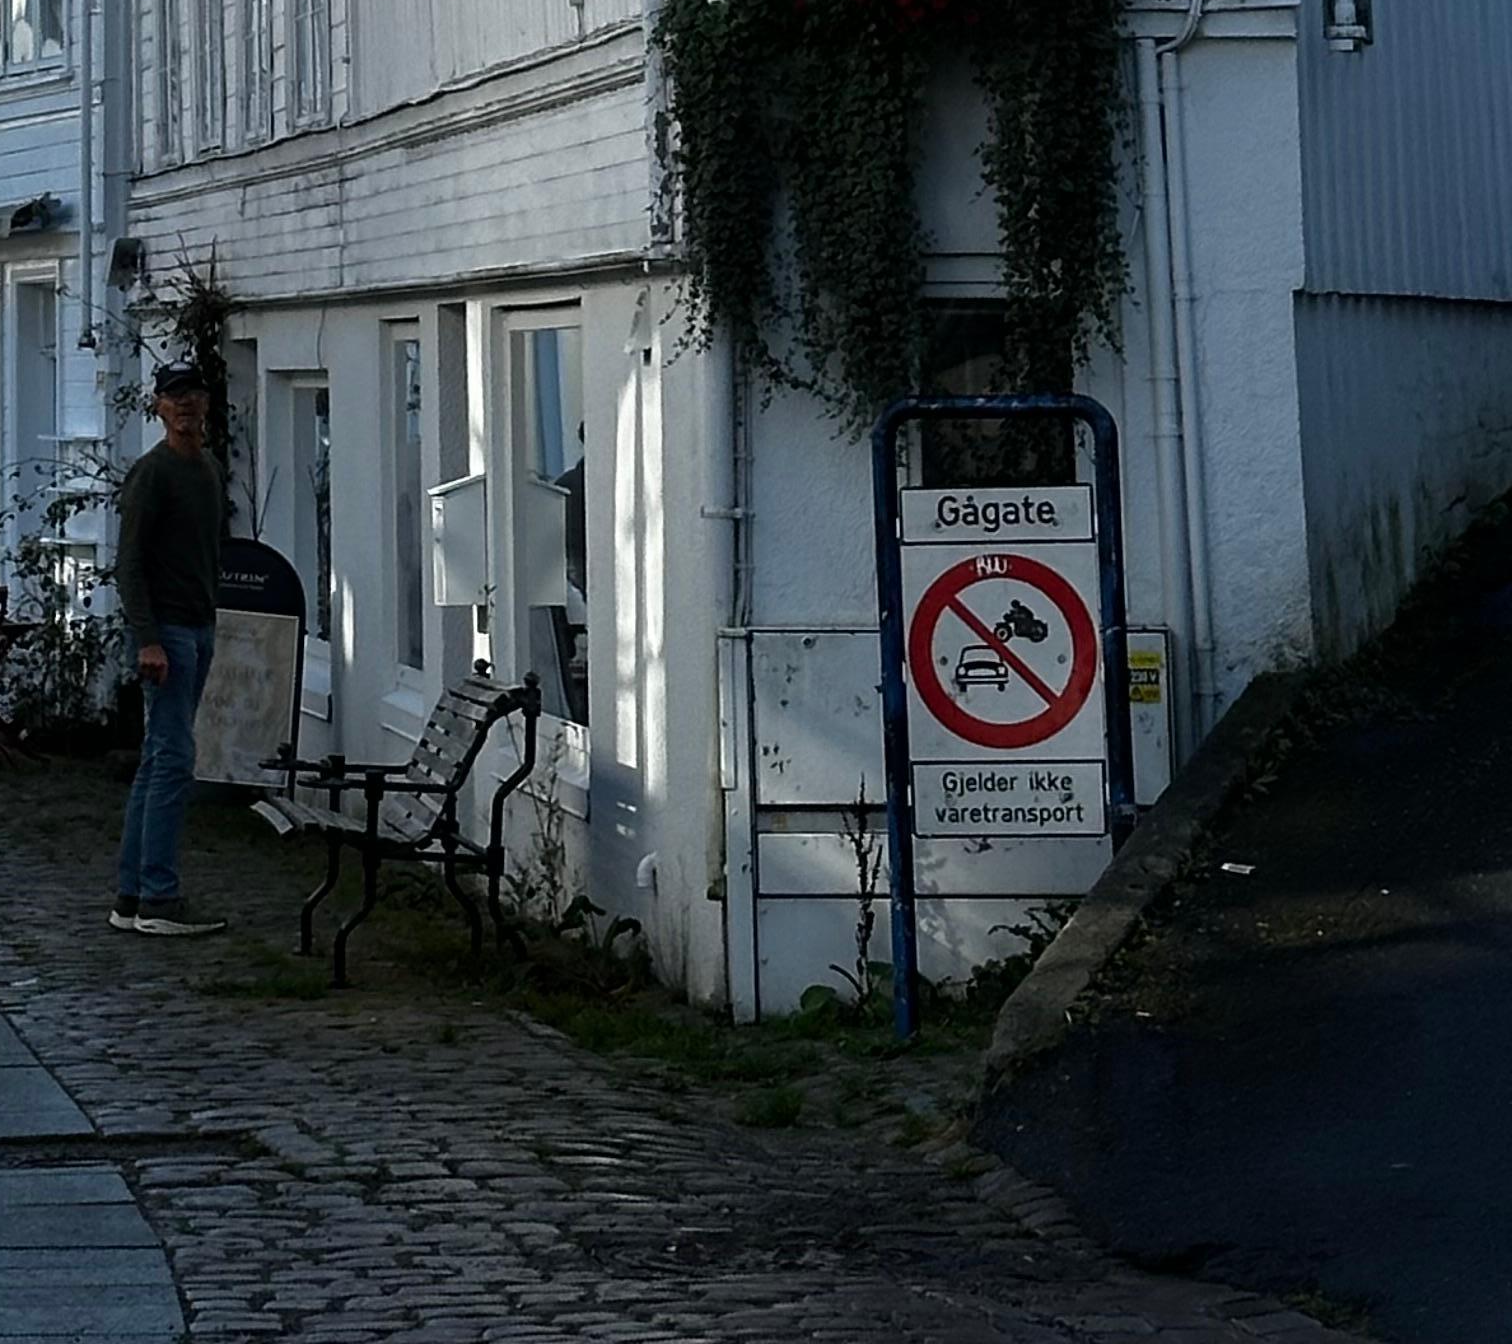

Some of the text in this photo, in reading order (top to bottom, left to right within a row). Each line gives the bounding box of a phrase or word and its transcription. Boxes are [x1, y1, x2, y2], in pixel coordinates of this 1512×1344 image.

[937, 495, 1056, 533] Gågate
[942, 771, 1073, 797] Gjelder ikke
[935, 803, 1085, 827] varetransport
